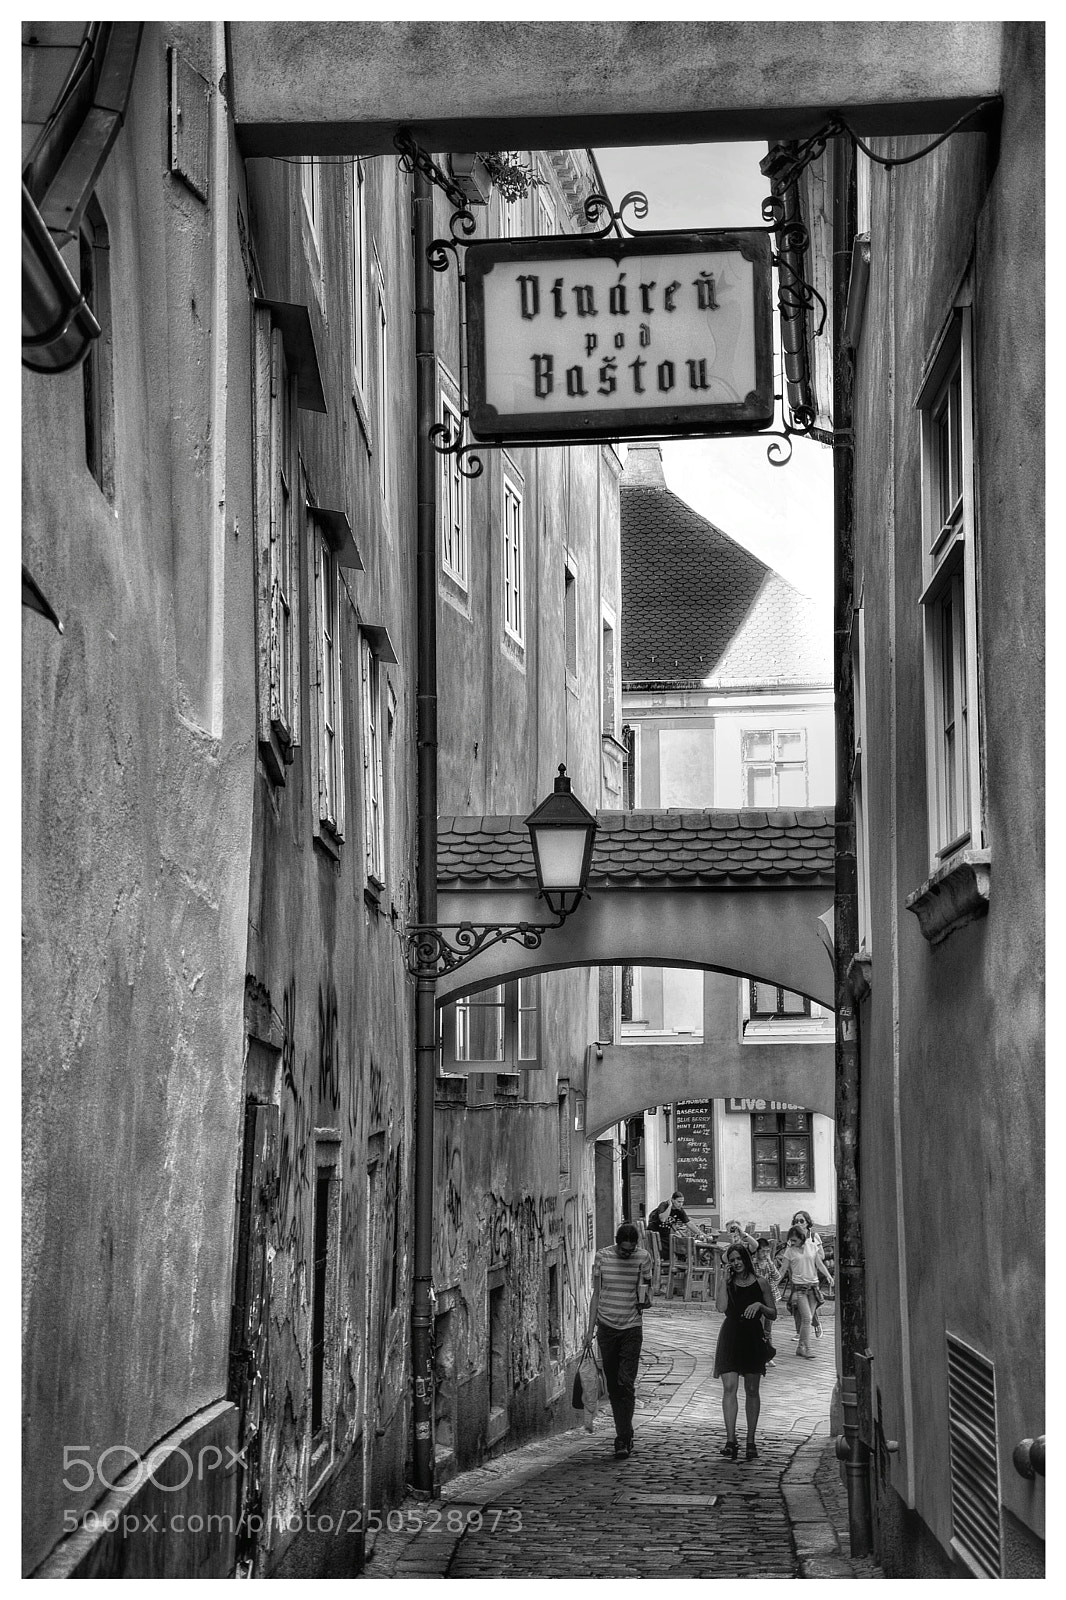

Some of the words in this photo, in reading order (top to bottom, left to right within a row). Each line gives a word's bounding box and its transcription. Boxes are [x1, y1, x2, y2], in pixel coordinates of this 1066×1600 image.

[584, 323, 651, 357] pod
[530, 353, 711, 399] Baštou
[730, 1098, 766, 1110] Live
